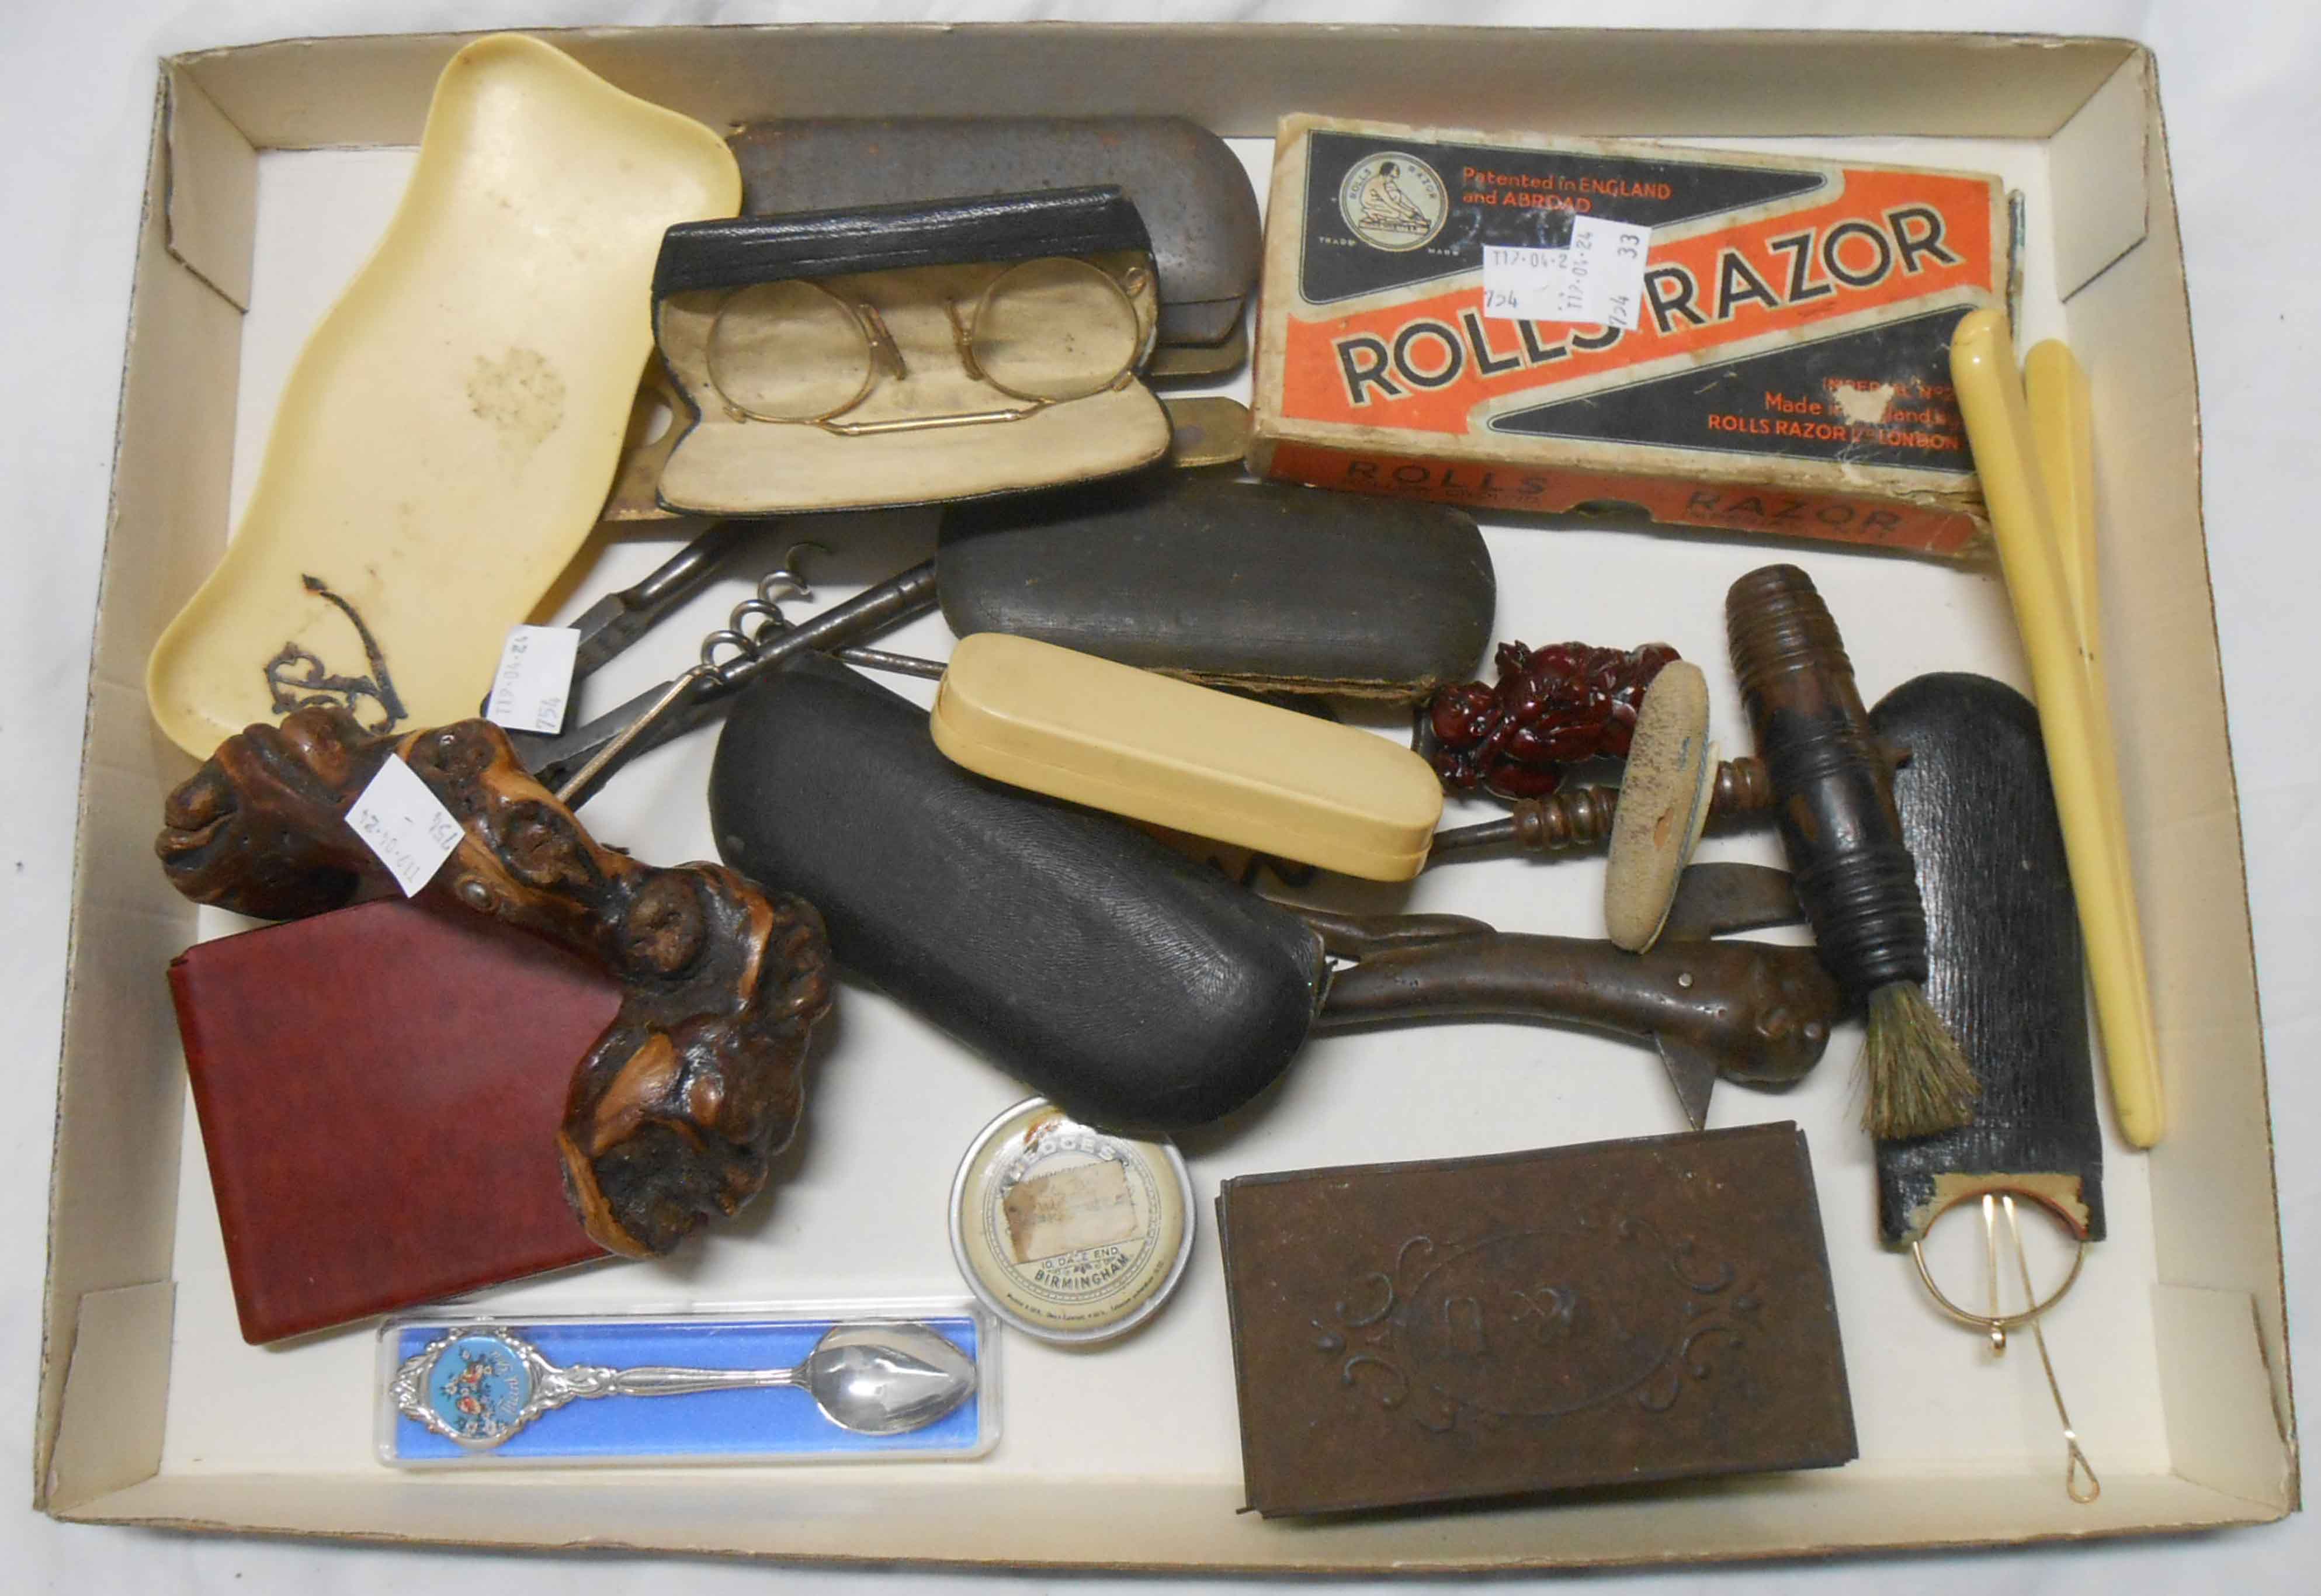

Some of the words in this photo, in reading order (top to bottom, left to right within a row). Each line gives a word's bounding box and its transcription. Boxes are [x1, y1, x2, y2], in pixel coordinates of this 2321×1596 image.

[1463, 166, 1555, 190] Patented
[1559, 177, 1576, 192] in
[1579, 178, 1673, 200] ENGLAND
[1463, 189, 1497, 205] and
[1503, 192, 1593, 214] ABROAD
[1643, 206, 1958, 334] RAZOR
[1765, 391, 1823, 416] Made
[1708, 414, 1771, 436] ROLLS
[1775, 420, 1847, 442] RAZOR
[1878, 429, 1965, 450] LONDON
[1347, 462, 1548, 495] ROLLS
[1686, 490, 1901, 536] RAZOR
[1094, 1246, 1119, 1261] END
[1035, 1254, 1129, 1290] BIRMINGHAM
